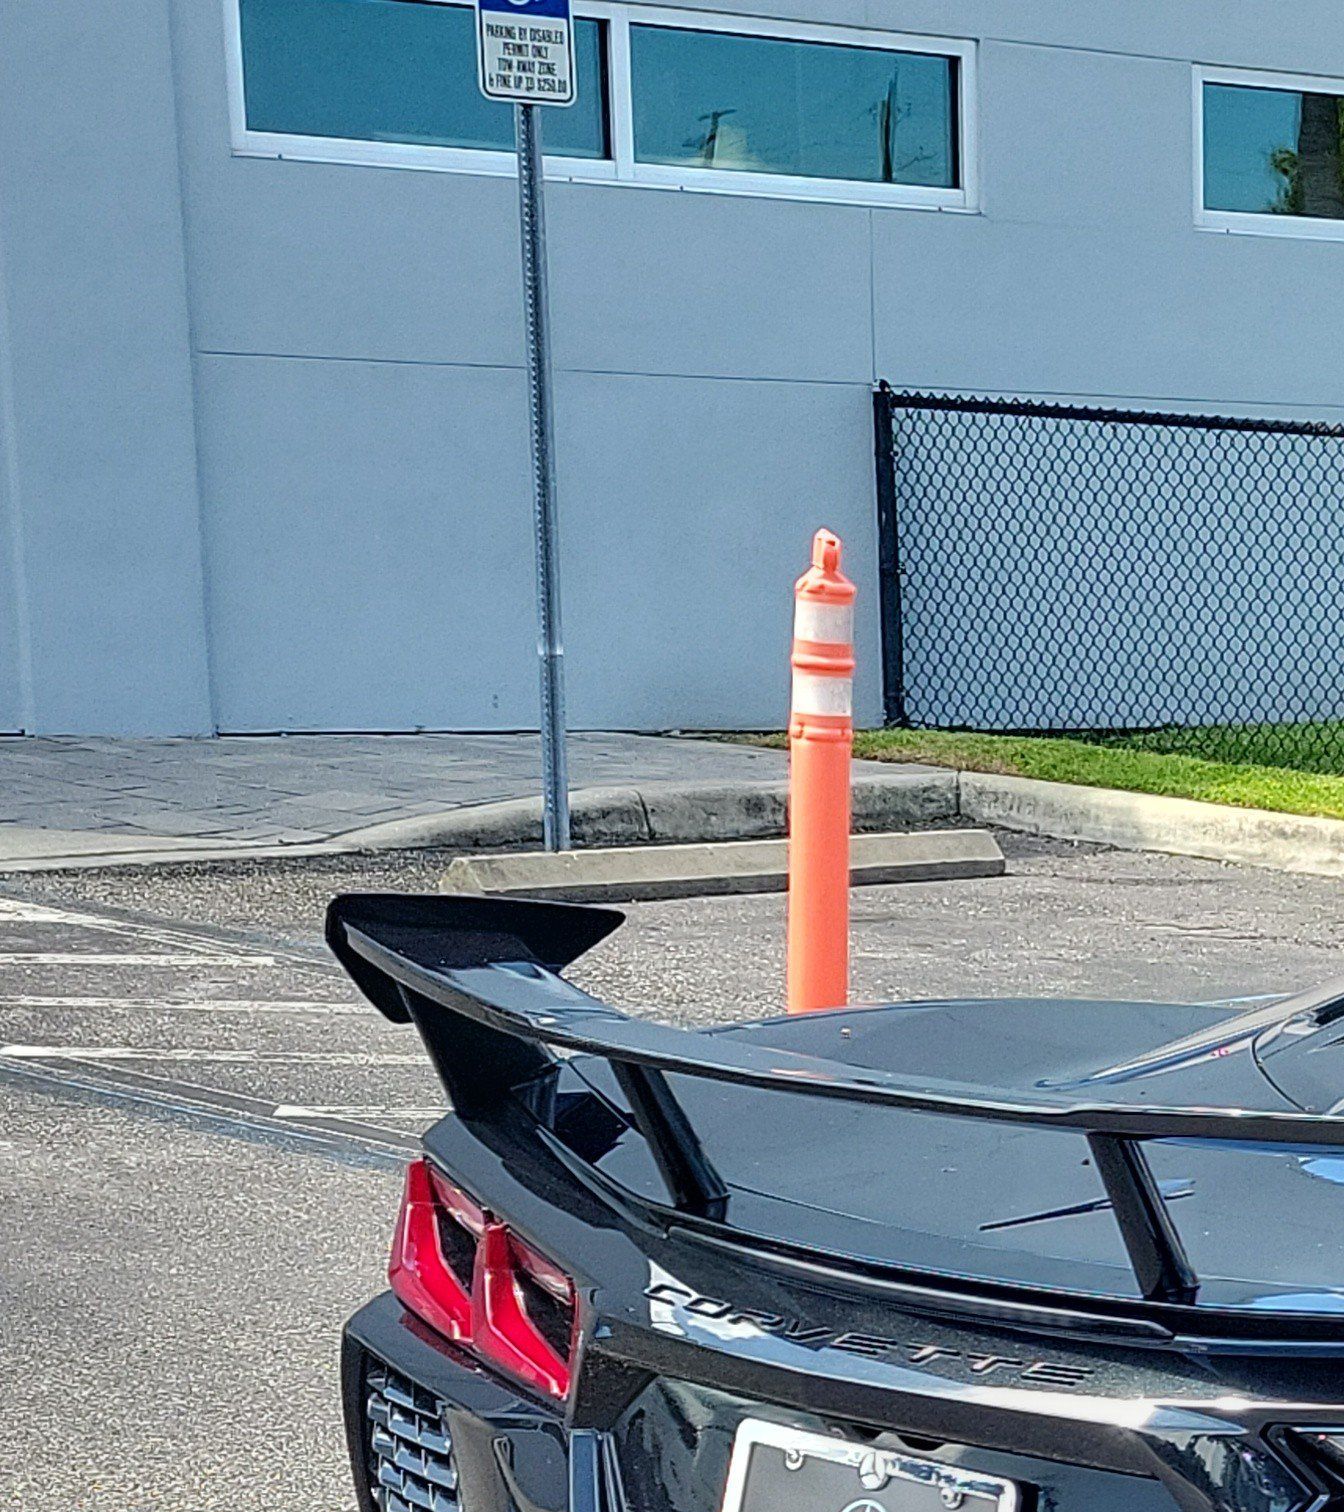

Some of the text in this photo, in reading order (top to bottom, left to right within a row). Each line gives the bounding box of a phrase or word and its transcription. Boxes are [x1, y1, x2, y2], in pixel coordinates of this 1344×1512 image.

[486, 23, 564, 45] PARKING BY DISABLED
[502, 42, 549, 59] PERMIT ONLY
[517, 60, 535, 74] AWAY
[538, 61, 557, 76] ZONE
[496, 73, 512, 88] FINE
[514, 75, 523, 89] UP
[644, 1284, 1096, 1387] CORVETTE
